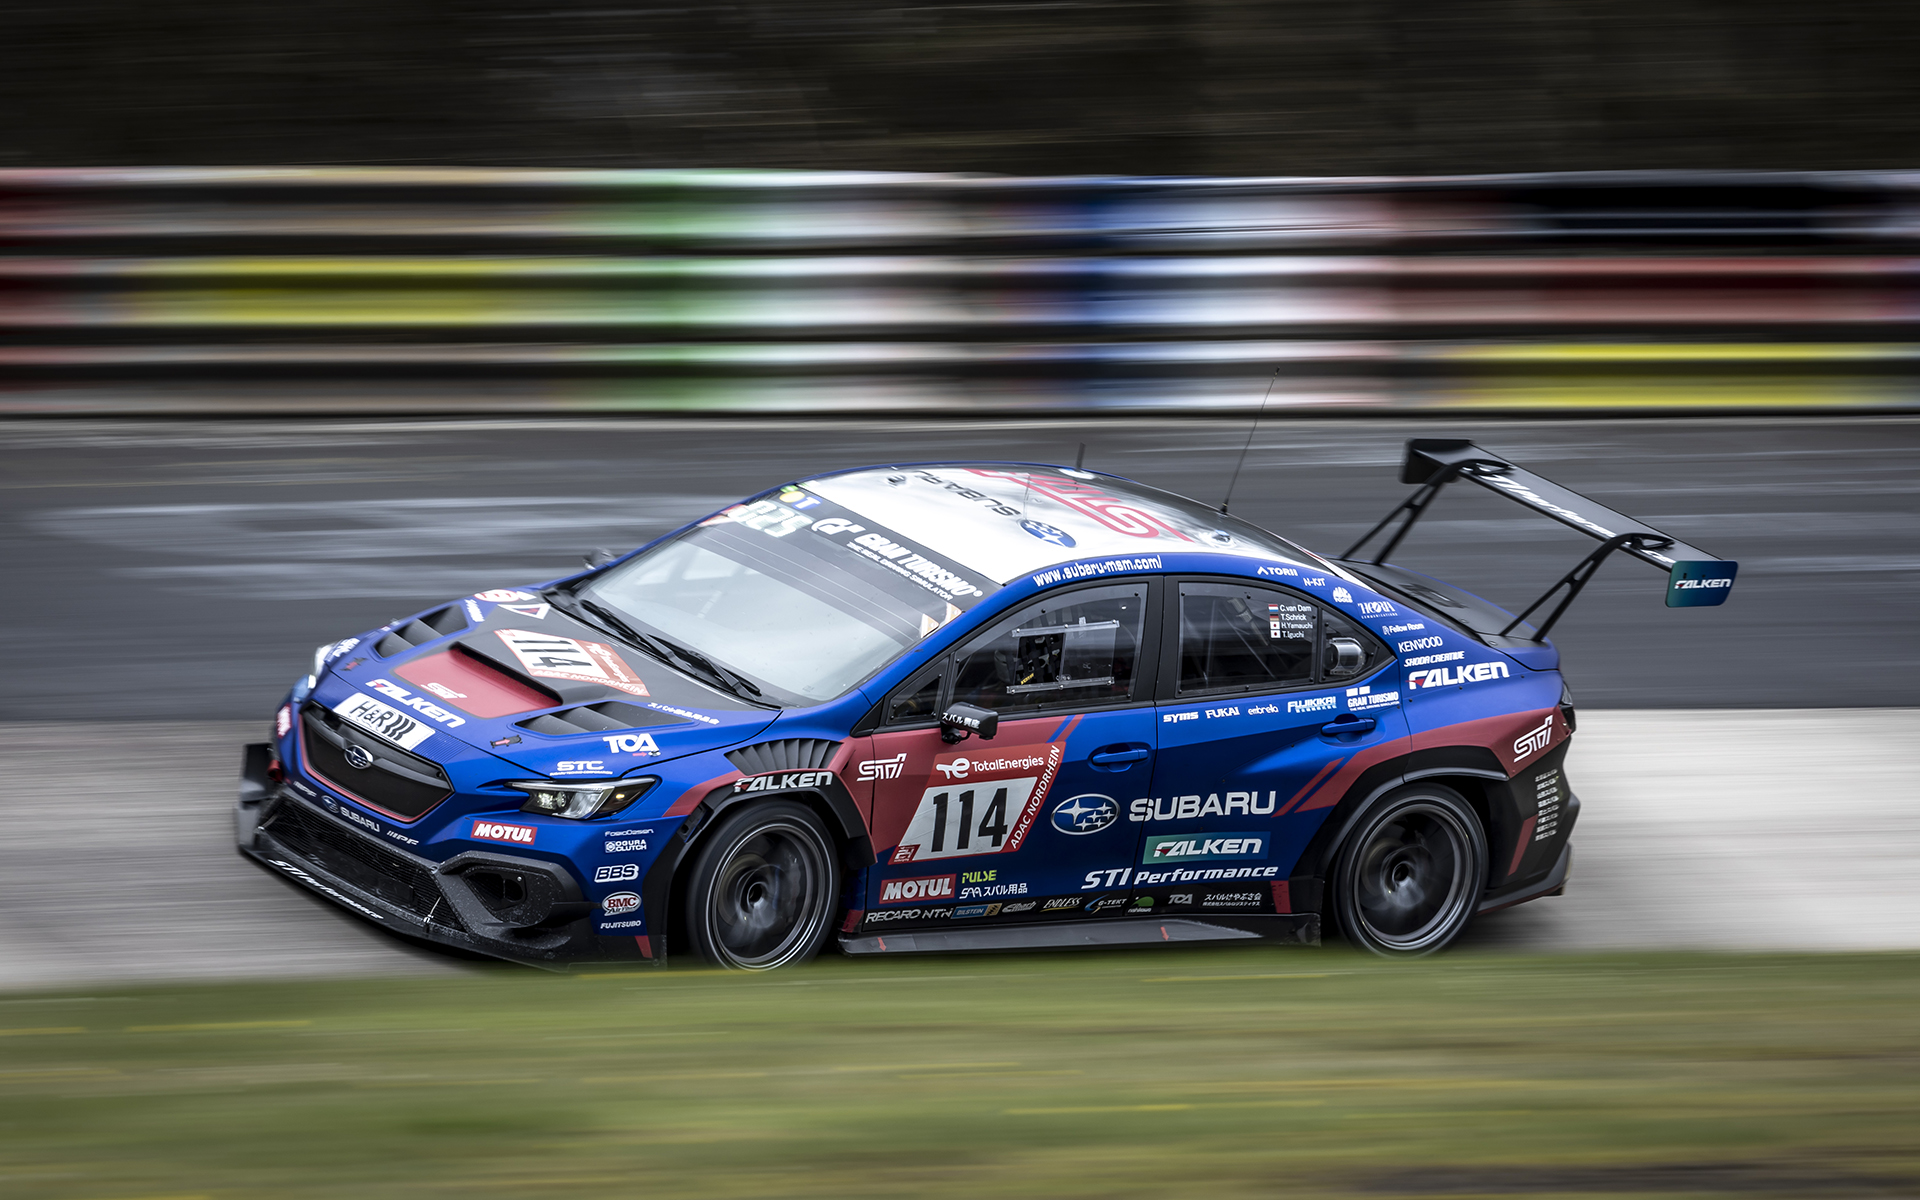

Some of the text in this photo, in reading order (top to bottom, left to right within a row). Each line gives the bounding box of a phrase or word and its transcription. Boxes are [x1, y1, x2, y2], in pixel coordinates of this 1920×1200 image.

[914, 469, 1021, 518] SUBARU
[854, 533, 977, 596] GRAN TURISMO
[909, 574, 953, 601] SIMULATOR
[1303, 577, 1326, 586] N-KIT
[1674, 579, 1732, 590] FALKEN
[1280, 613, 1307, 621] T.Schrick
[1282, 630, 1305, 639] T.Iguchi
[1397, 636, 1444, 653] KENWOOD
[512, 640, 593, 668] 114
[569, 673, 645, 694] NORDRHEIN
[1406, 661, 1510, 690] FALKEN
[365, 678, 466, 728] FALKEN
[1348, 696, 1367, 708] GRAN
[1367, 691, 1399, 705] TURISMO
[350, 699, 394, 732] H&R
[1205, 707, 1240, 719] FUKAI
[602, 733, 660, 753] TOA
[557, 761, 604, 771] STC
[972, 756, 1044, 771] TotalEnergies
[733, 771, 833, 792] FALKEN
[1010, 745, 1060, 849] ADAC NORDRHEIN
[1129, 791, 1276, 822] SUBARU
[339, 806, 380, 832] SUBARU
[931, 787, 1008, 853] 114
[474, 823, 533, 843] MOTUL
[615, 839, 646, 847] OGURA
[615, 844, 647, 852] CLUTCH
[1153, 838, 1263, 857] FALKEN
[594, 863, 639, 883] BBS
[961, 870, 997, 884] PULSE
[1081, 866, 1279, 889] STI Performance
[882, 878, 952, 901] MOTUL
[982, 882, 1028, 897] スバル用品
[607, 897, 637, 908] BMC
[1043, 897, 1083, 909] ENDLESS
[1098, 898, 1127, 906] G-TEKT
[1168, 894, 1193, 904] TOA
[865, 909, 920, 923] RECARO
[922, 907, 952, 919] NTN
[956, 907, 984, 916] BILSTEIN
[600, 920, 642, 929] FUJITSUBO
